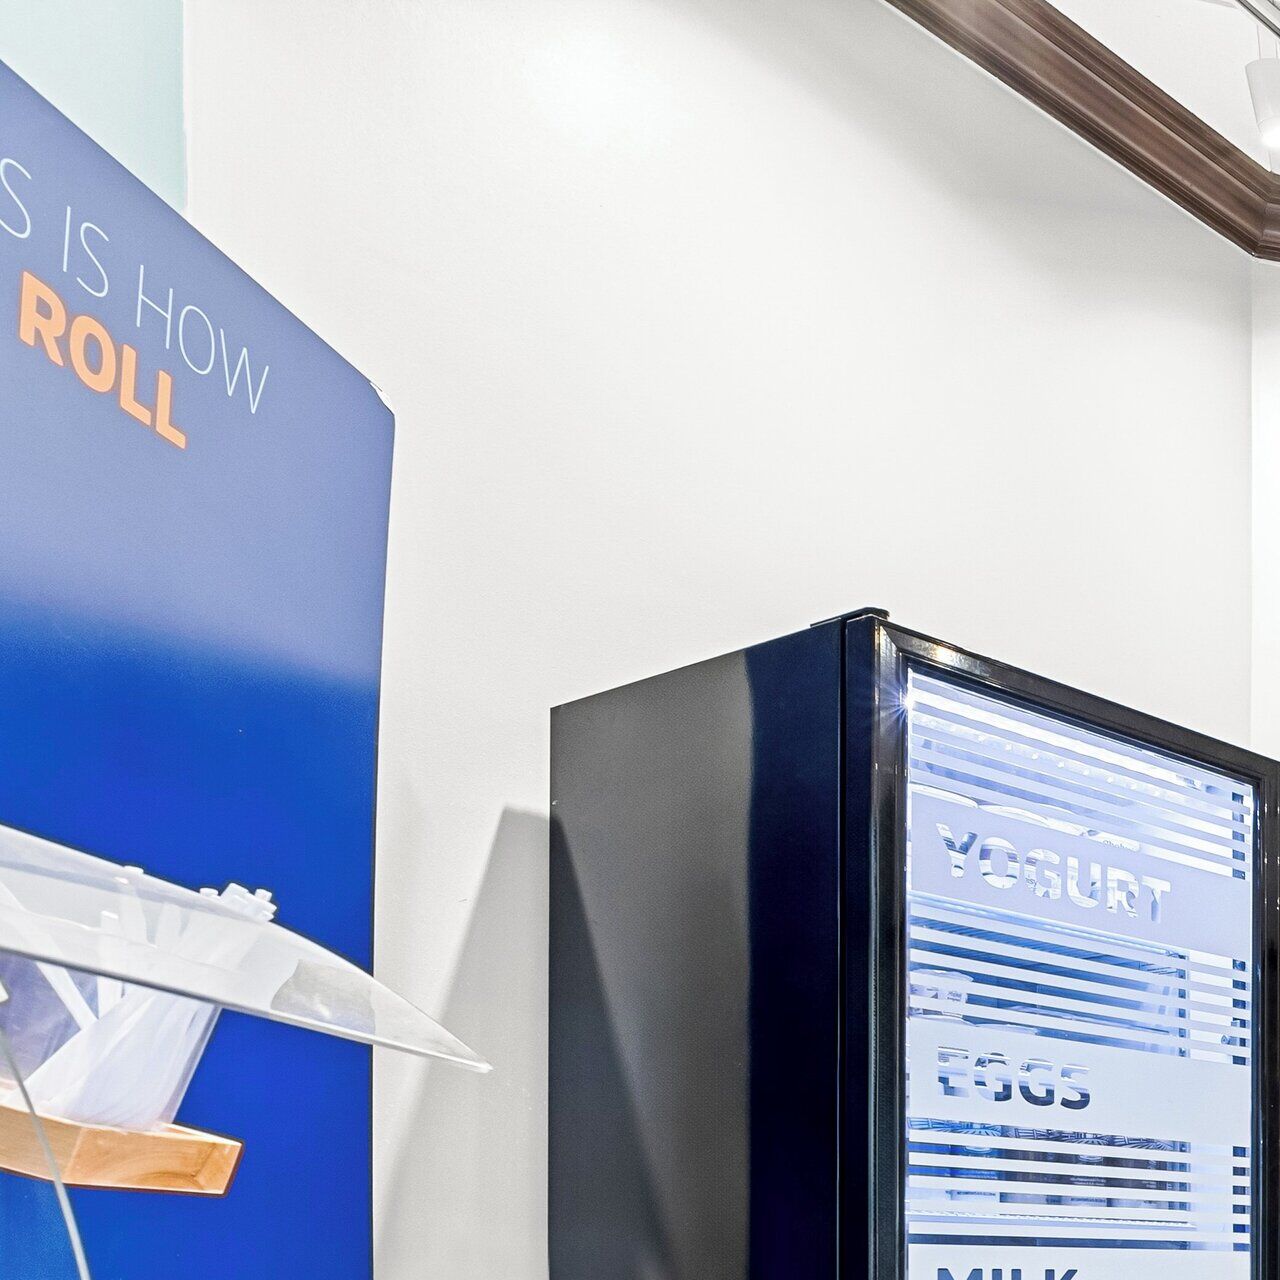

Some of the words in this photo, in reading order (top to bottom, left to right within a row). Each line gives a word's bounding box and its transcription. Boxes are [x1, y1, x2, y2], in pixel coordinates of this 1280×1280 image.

[18, 269, 188, 450] ROLL
[63, 206, 109, 298] IS
[136, 264, 269, 414] HOW
[935, 822, 1172, 924] YOGURT
[937, 1045, 1091, 1110] EGGS
